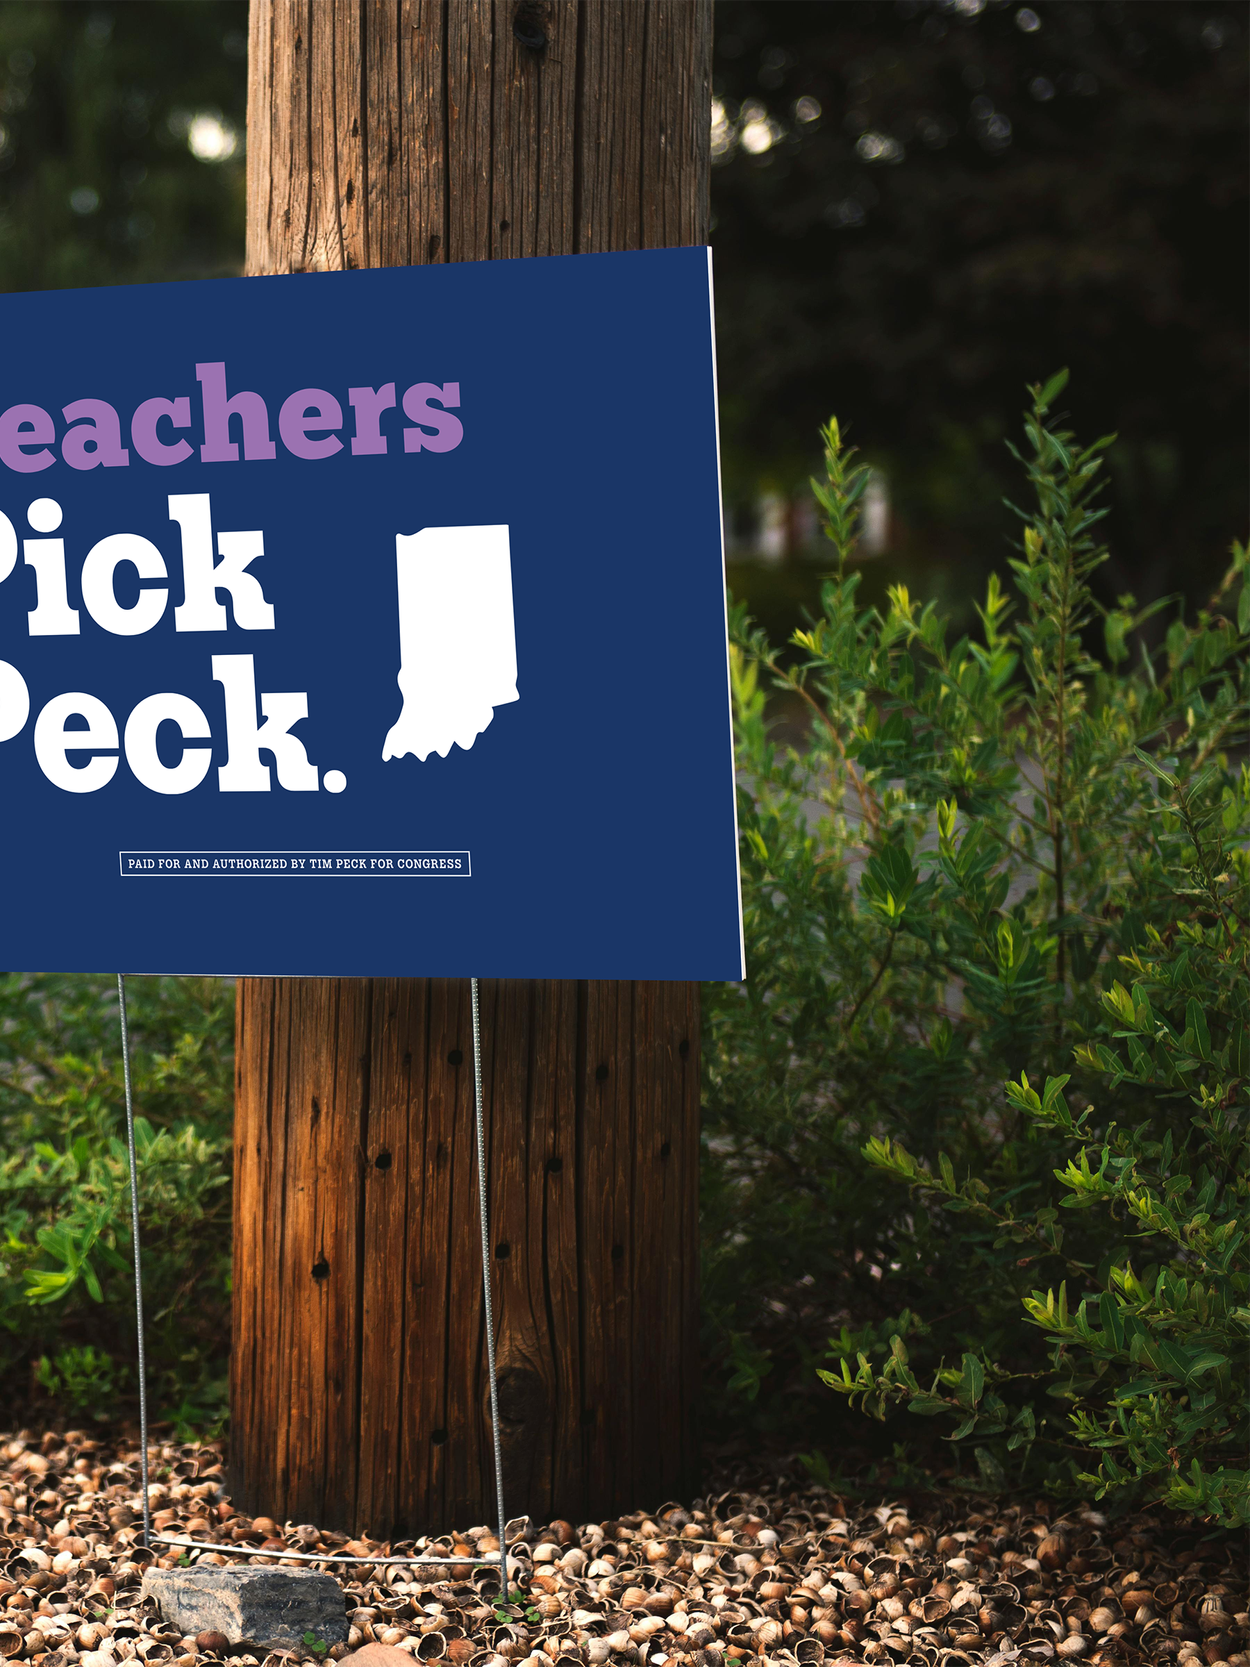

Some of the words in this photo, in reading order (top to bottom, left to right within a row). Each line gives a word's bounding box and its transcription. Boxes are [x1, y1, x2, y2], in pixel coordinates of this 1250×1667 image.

[127, 858, 156, 869] PAID
[157, 858, 182, 869] FOR
[183, 858, 210, 869] AND
[212, 858, 288, 869] AUTHORIZED
[290, 858, 307, 869] BY
[309, 858, 333, 869] TIM
[335, 858, 368, 869] PECK
[369, 858, 395, 869] FOR
[396, 858, 462, 869] CONGRESS
